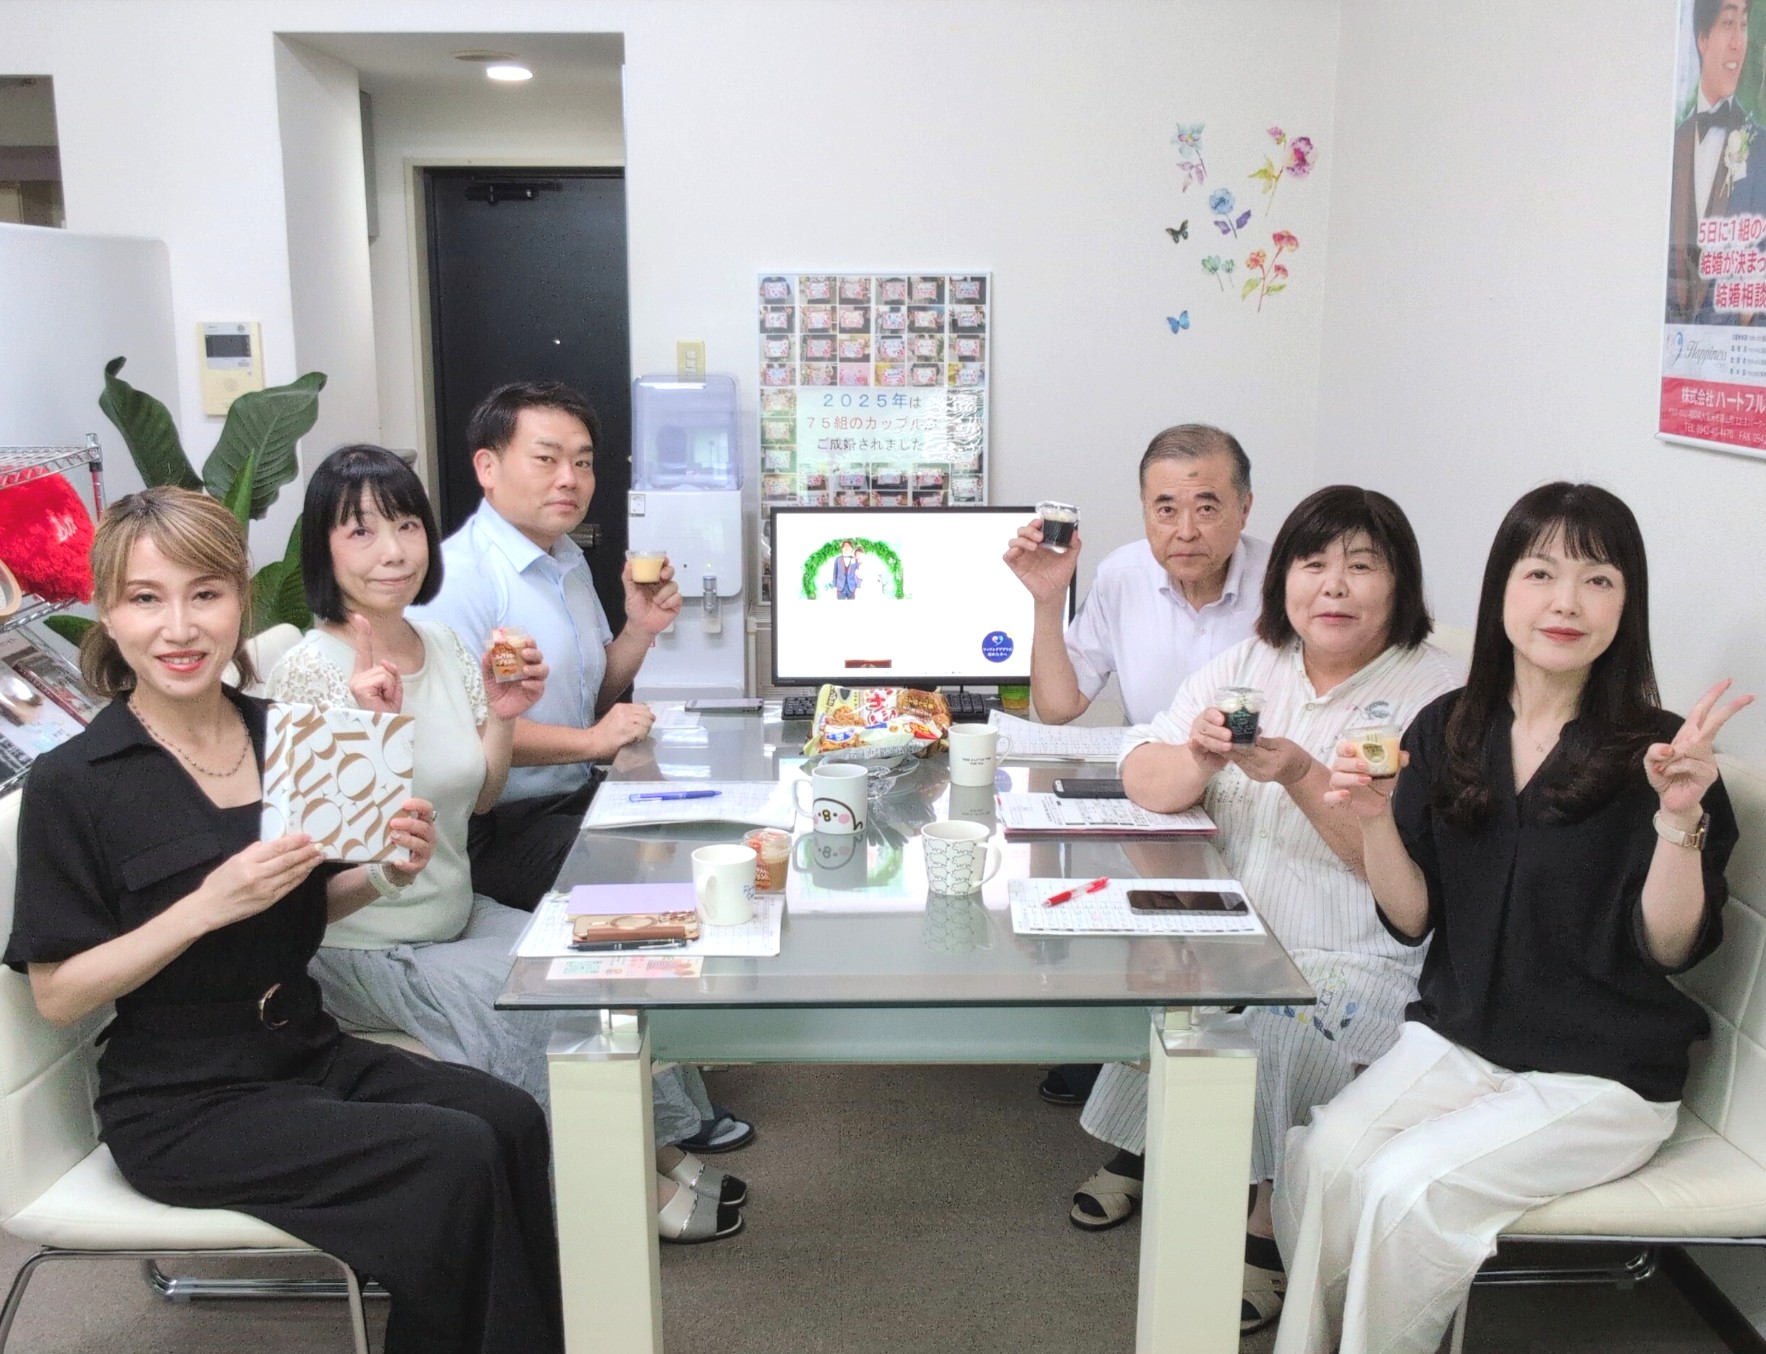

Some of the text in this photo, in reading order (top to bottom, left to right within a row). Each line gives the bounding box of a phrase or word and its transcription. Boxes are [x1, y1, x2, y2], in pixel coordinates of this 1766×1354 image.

[1698, 218, 1766, 244] 5日に1組の
[817, 438, 924, 451] ご成婚されました
